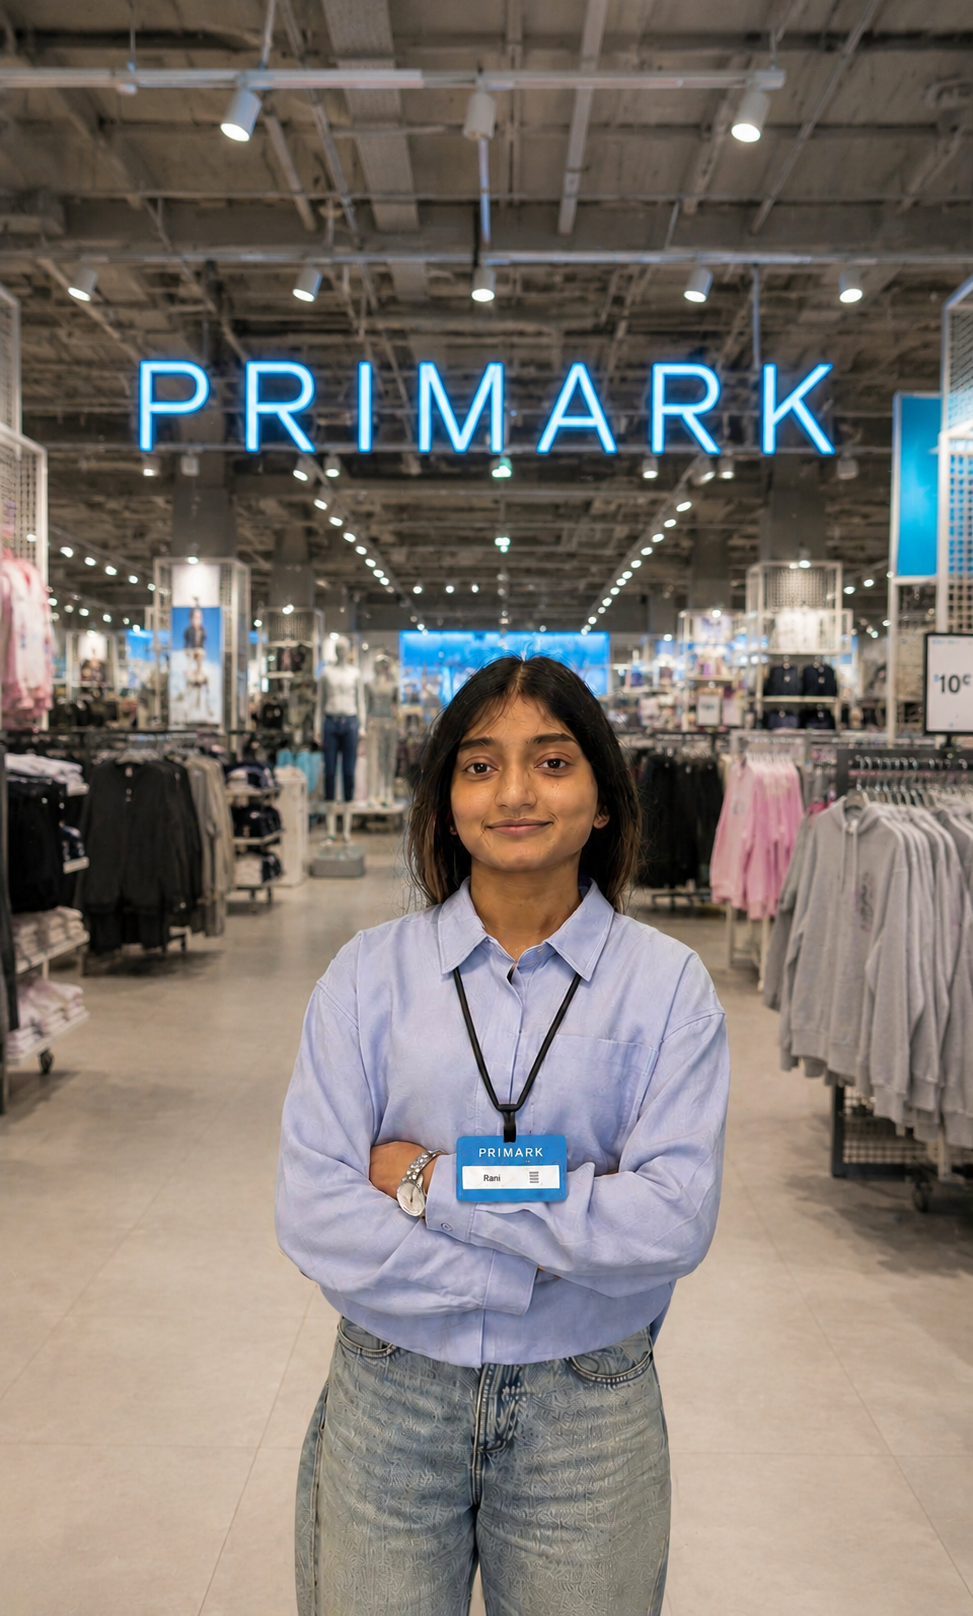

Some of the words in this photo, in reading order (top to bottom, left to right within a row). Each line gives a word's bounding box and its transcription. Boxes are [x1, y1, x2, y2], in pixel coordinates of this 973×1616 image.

[138, 360, 836, 454] PRIMARK
[478, 1147, 544, 1158] PRIMARK
[483, 1174, 501, 1182] Rani
